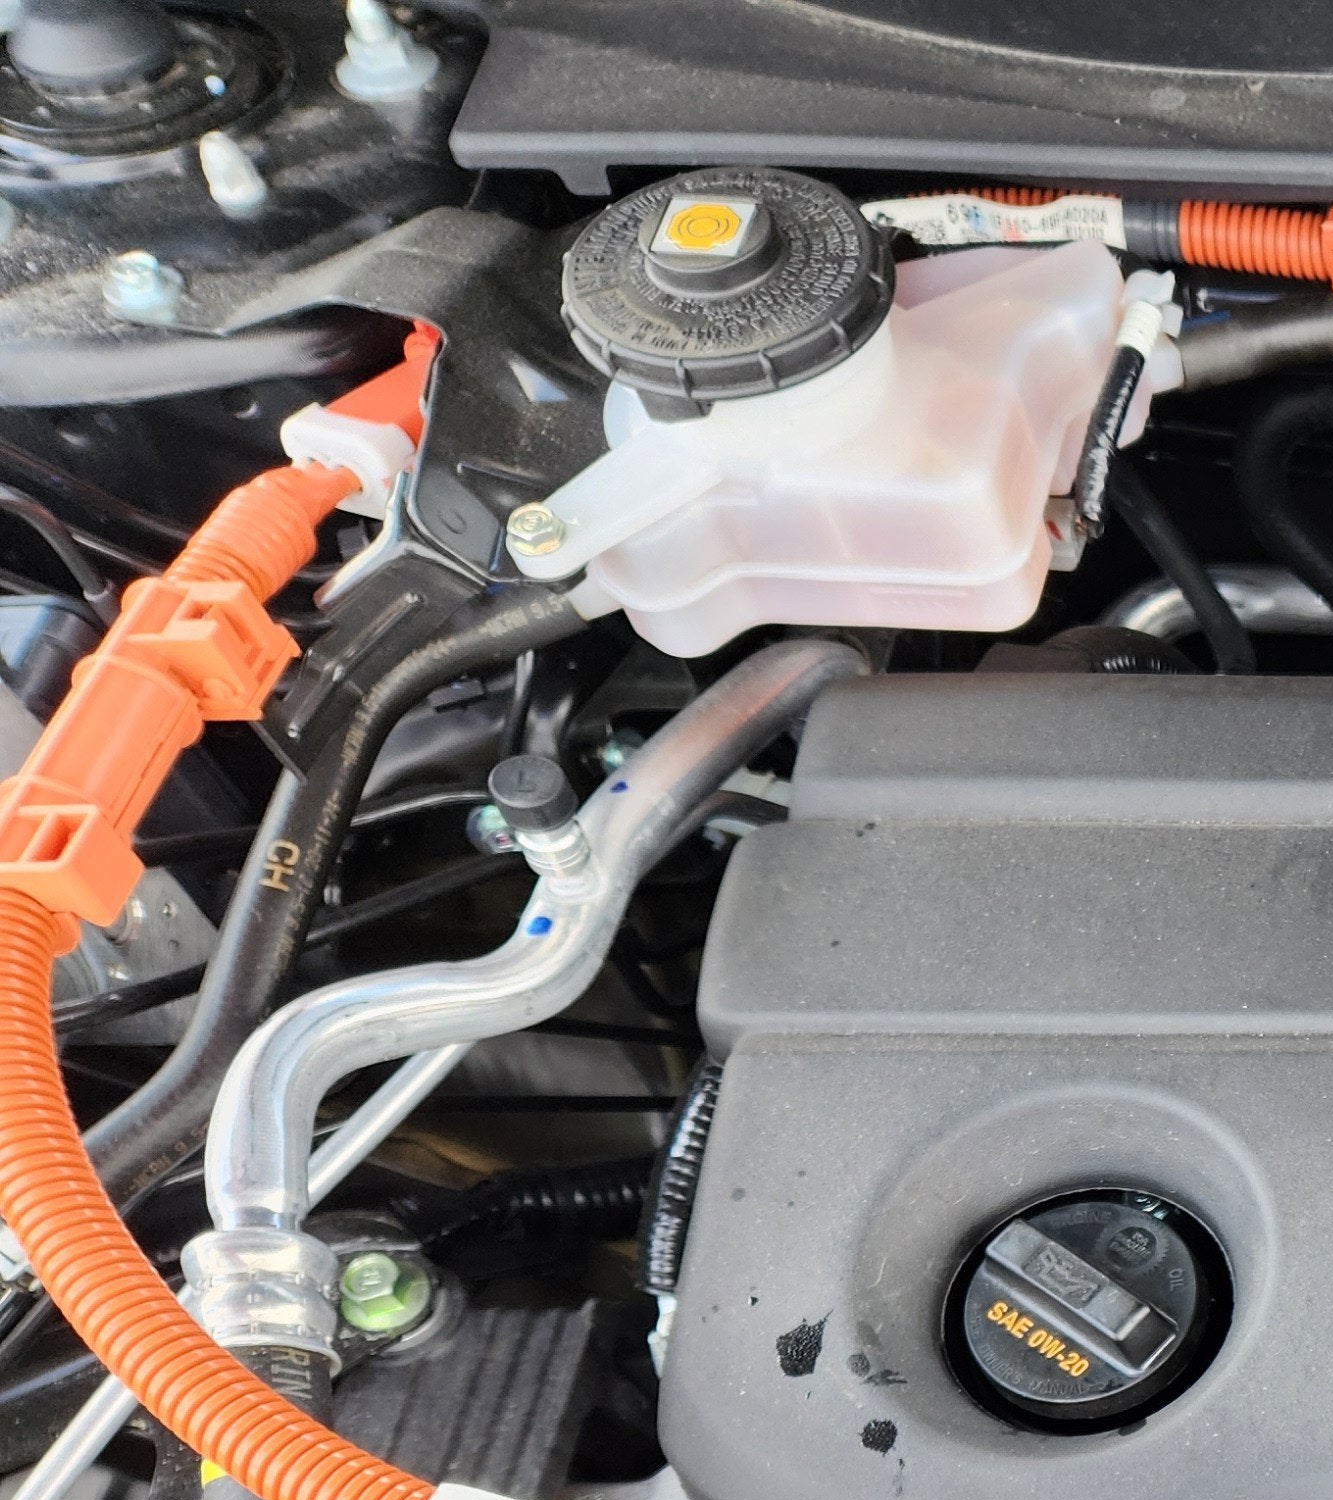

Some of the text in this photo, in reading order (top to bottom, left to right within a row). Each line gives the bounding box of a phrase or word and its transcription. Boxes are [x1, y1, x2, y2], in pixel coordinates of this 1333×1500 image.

[259, 838, 301, 892] CH
[1168, 1267, 1184, 1292] OIL
[987, 1302, 1034, 1339] SAE
[1027, 1329, 1090, 1377] 0W-20
